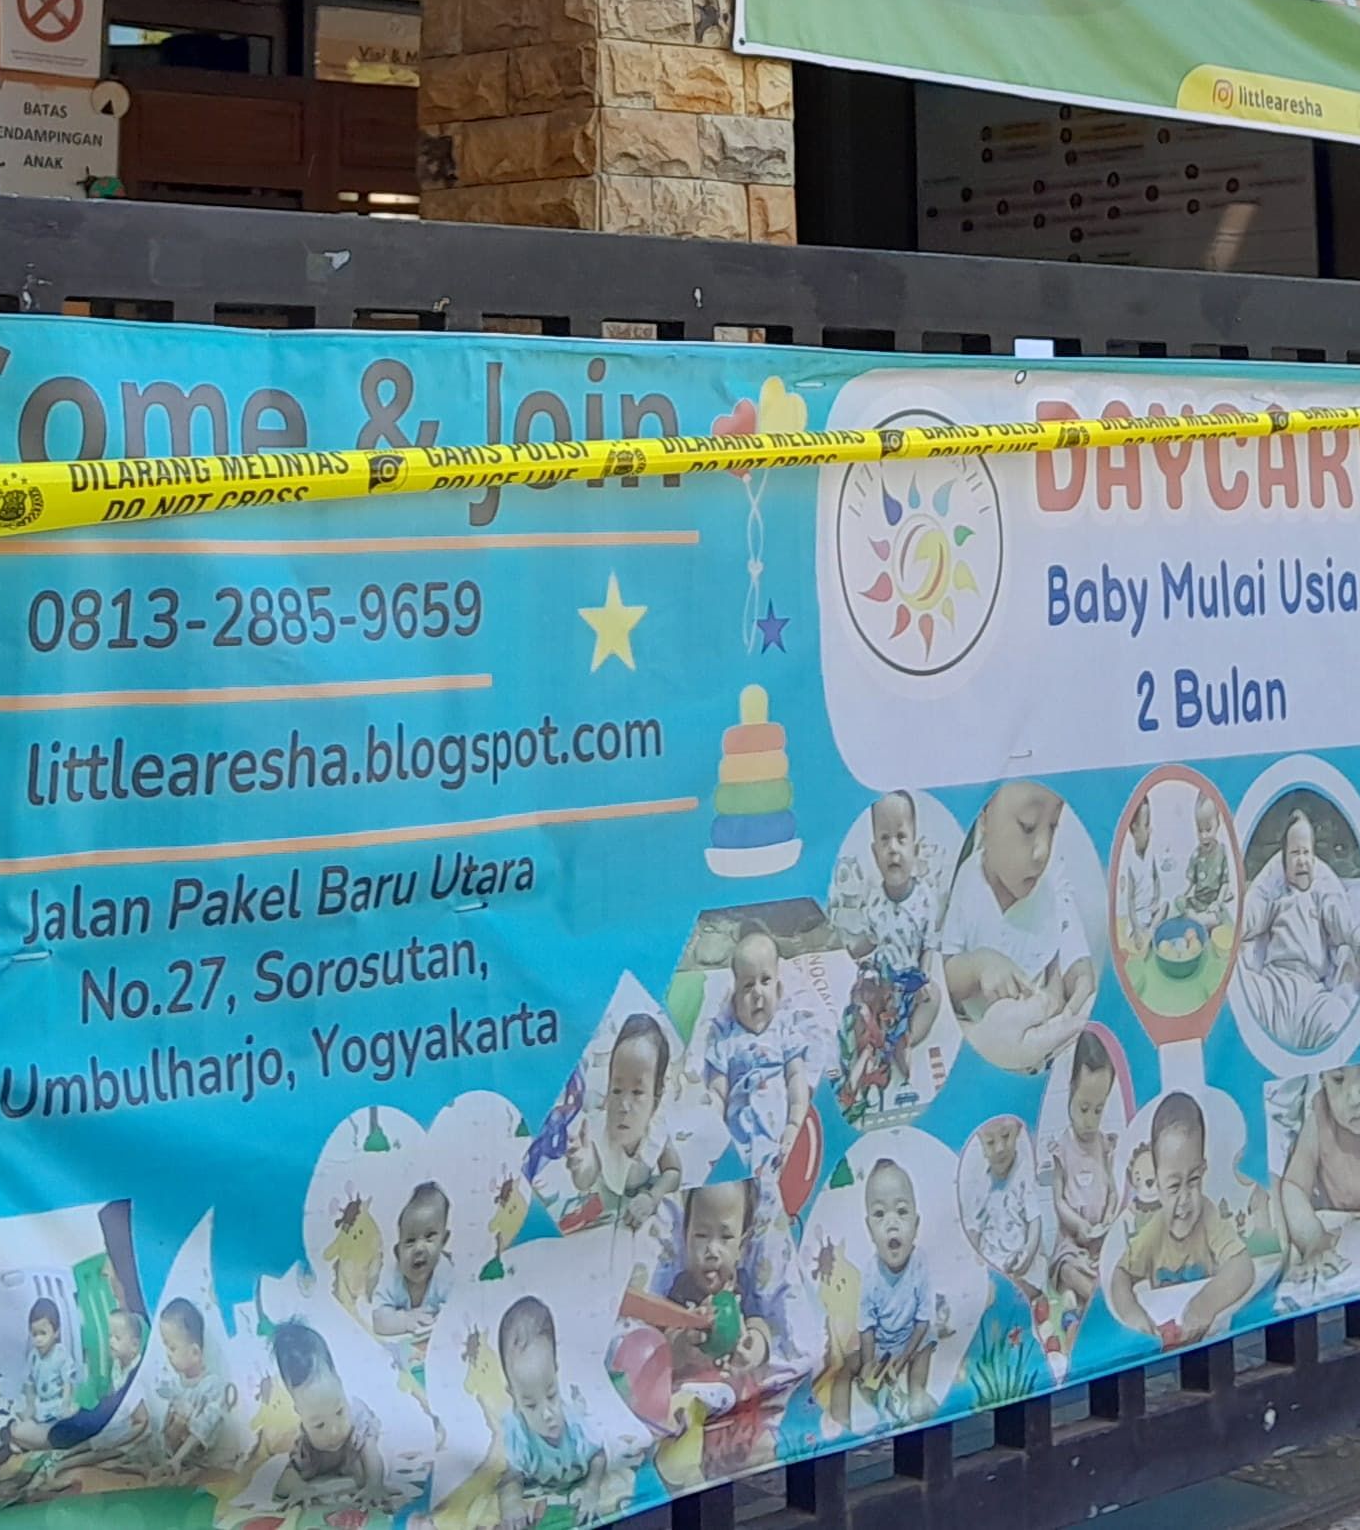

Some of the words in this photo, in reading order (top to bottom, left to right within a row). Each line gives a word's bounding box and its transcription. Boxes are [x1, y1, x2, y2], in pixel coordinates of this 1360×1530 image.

[23, 102, 68, 118] BATAS
[1239, 86, 1323, 117] littlearesha
[23, 154, 64, 169] ANAK
[67, 457, 211, 493] DILARANG
[216, 451, 350, 483] MELINTAS
[423, 442, 502, 468] GARIS
[512, 439, 590, 462] POLISI
[469, 356, 681, 527] Join
[101, 498, 141, 522] DO
[151, 493, 210, 518] NOT
[27, 580, 483, 652] 0813-2885-9659
[1047, 562, 1148, 638] Baby
[1160, 558, 1266, 619] Mulai
[1279, 556, 1358, 614] Usia
[1137, 670, 1159, 732] 2
[1174, 665, 1287, 729] Bulan
[27, 716, 663, 806] littlearesha.blogspot.com
[22, 885, 150, 946] Jalan
[168, 869, 302, 932] Pakel
[317, 864, 418, 917] Baru
[429, 852, 536, 900] Utara
[81, 956, 237, 1025] No.27,
[253, 936, 490, 1004] Sorosutan,
[311, 1002, 561, 1082] Yogyakarta
